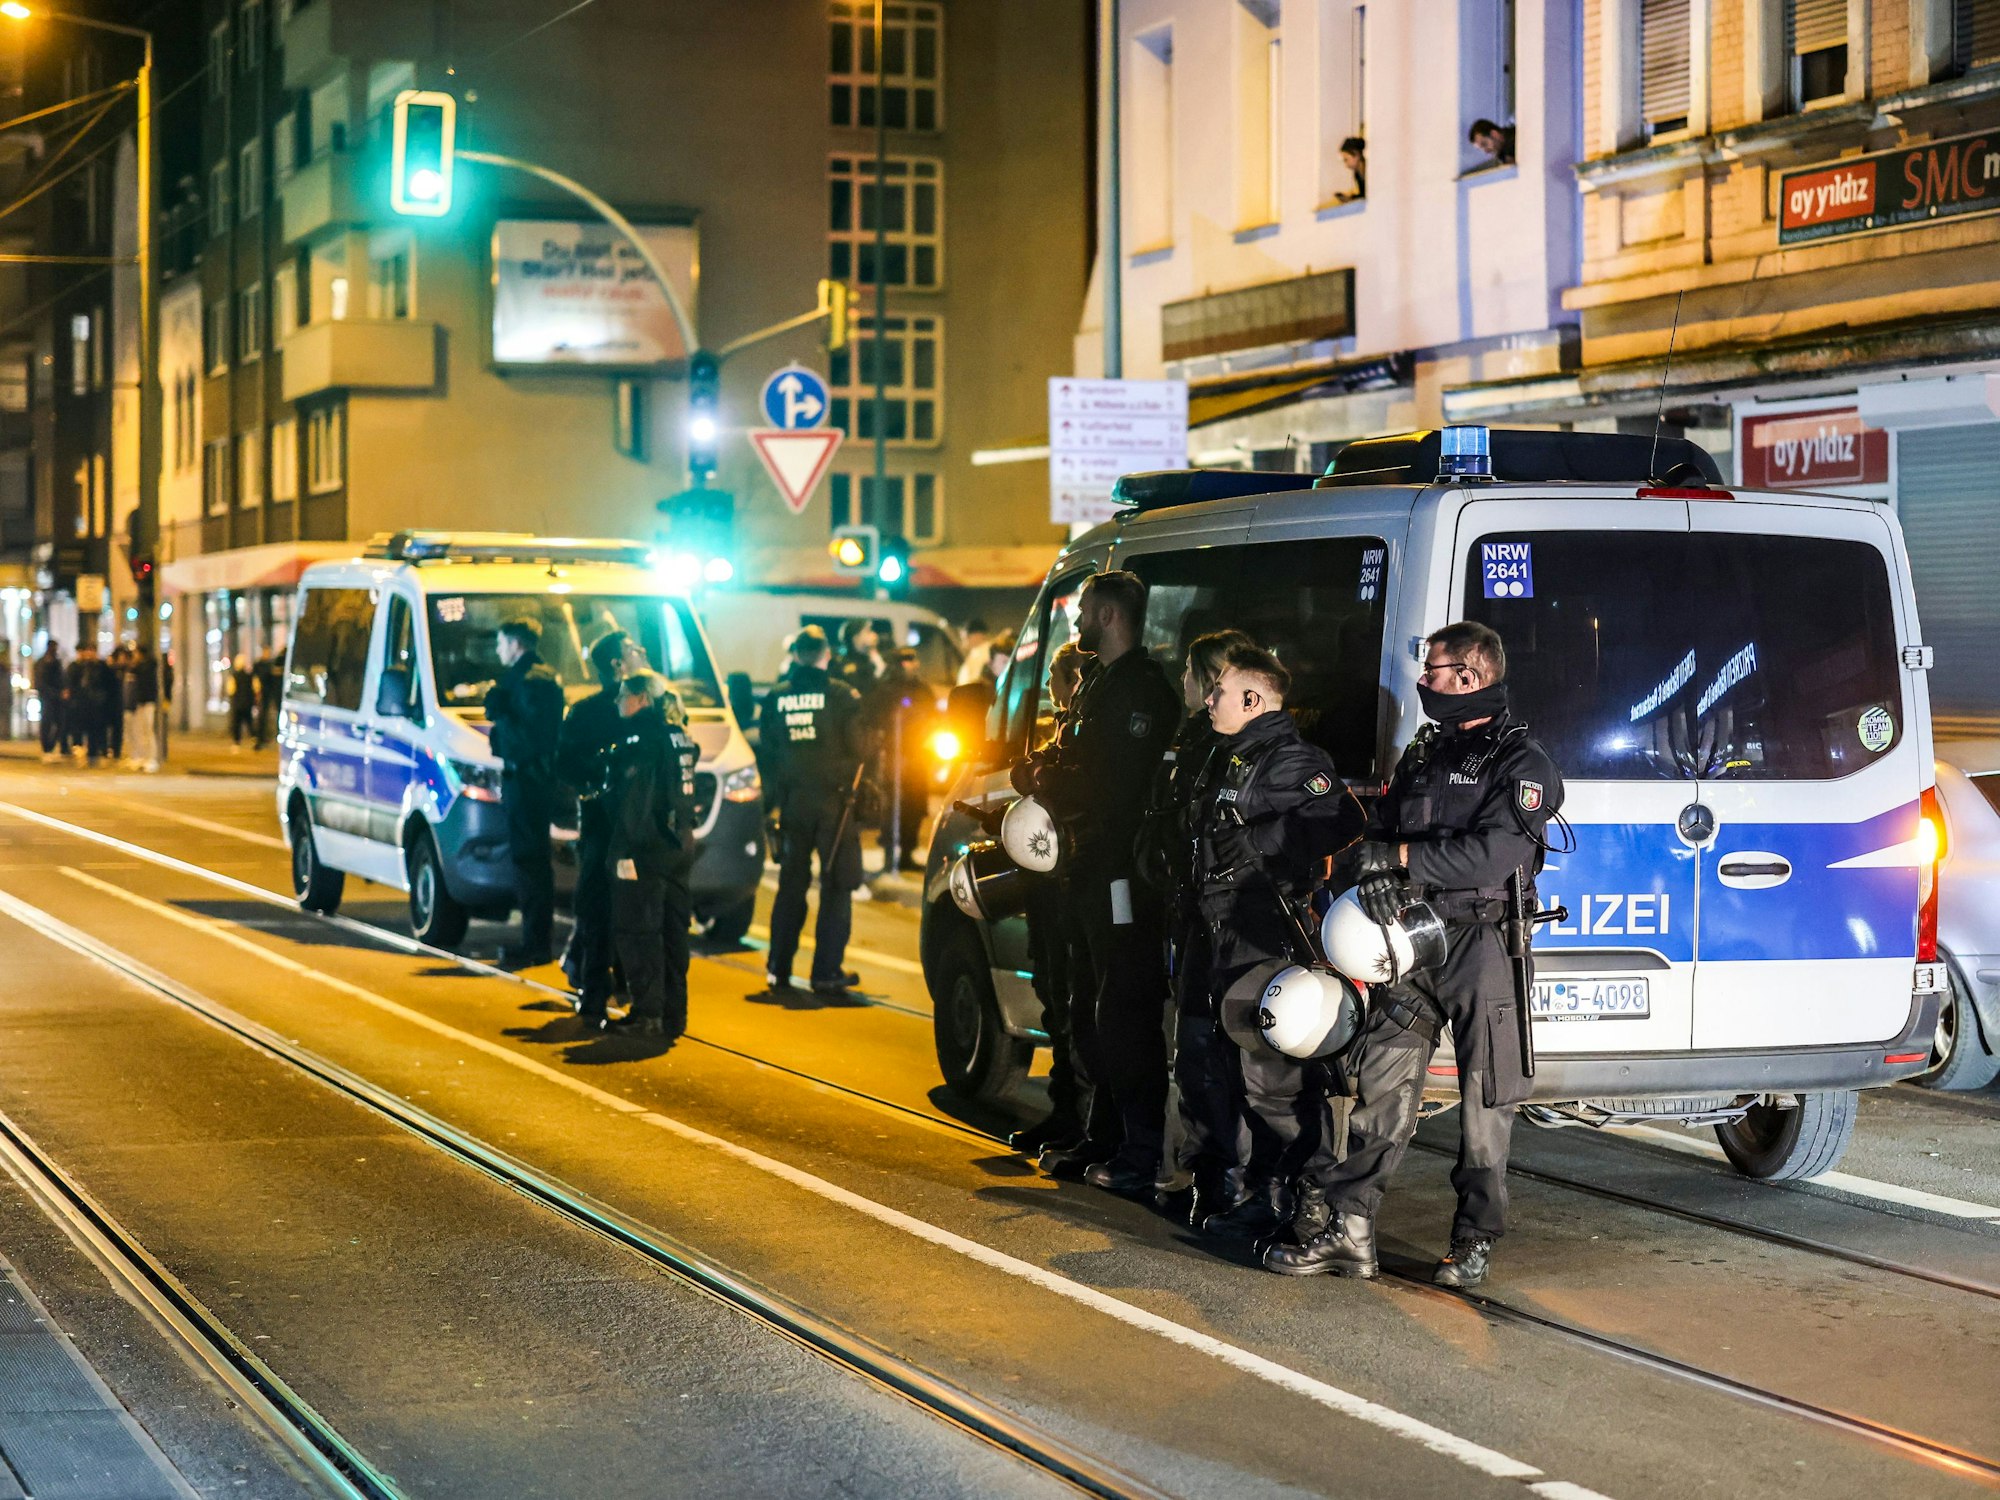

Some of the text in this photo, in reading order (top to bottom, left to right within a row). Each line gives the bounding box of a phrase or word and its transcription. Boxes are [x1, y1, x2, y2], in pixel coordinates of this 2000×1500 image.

[1902, 139, 1988, 210] SMC
[1790, 188, 1814, 220] ay
[1362, 549, 1384, 566] NRW
[1483, 544, 1528, 561] NRW
[1359, 567, 1380, 583] 2641
[1486, 562, 1528, 579] 2641
[1566, 984, 1645, 1011] 5-4098
